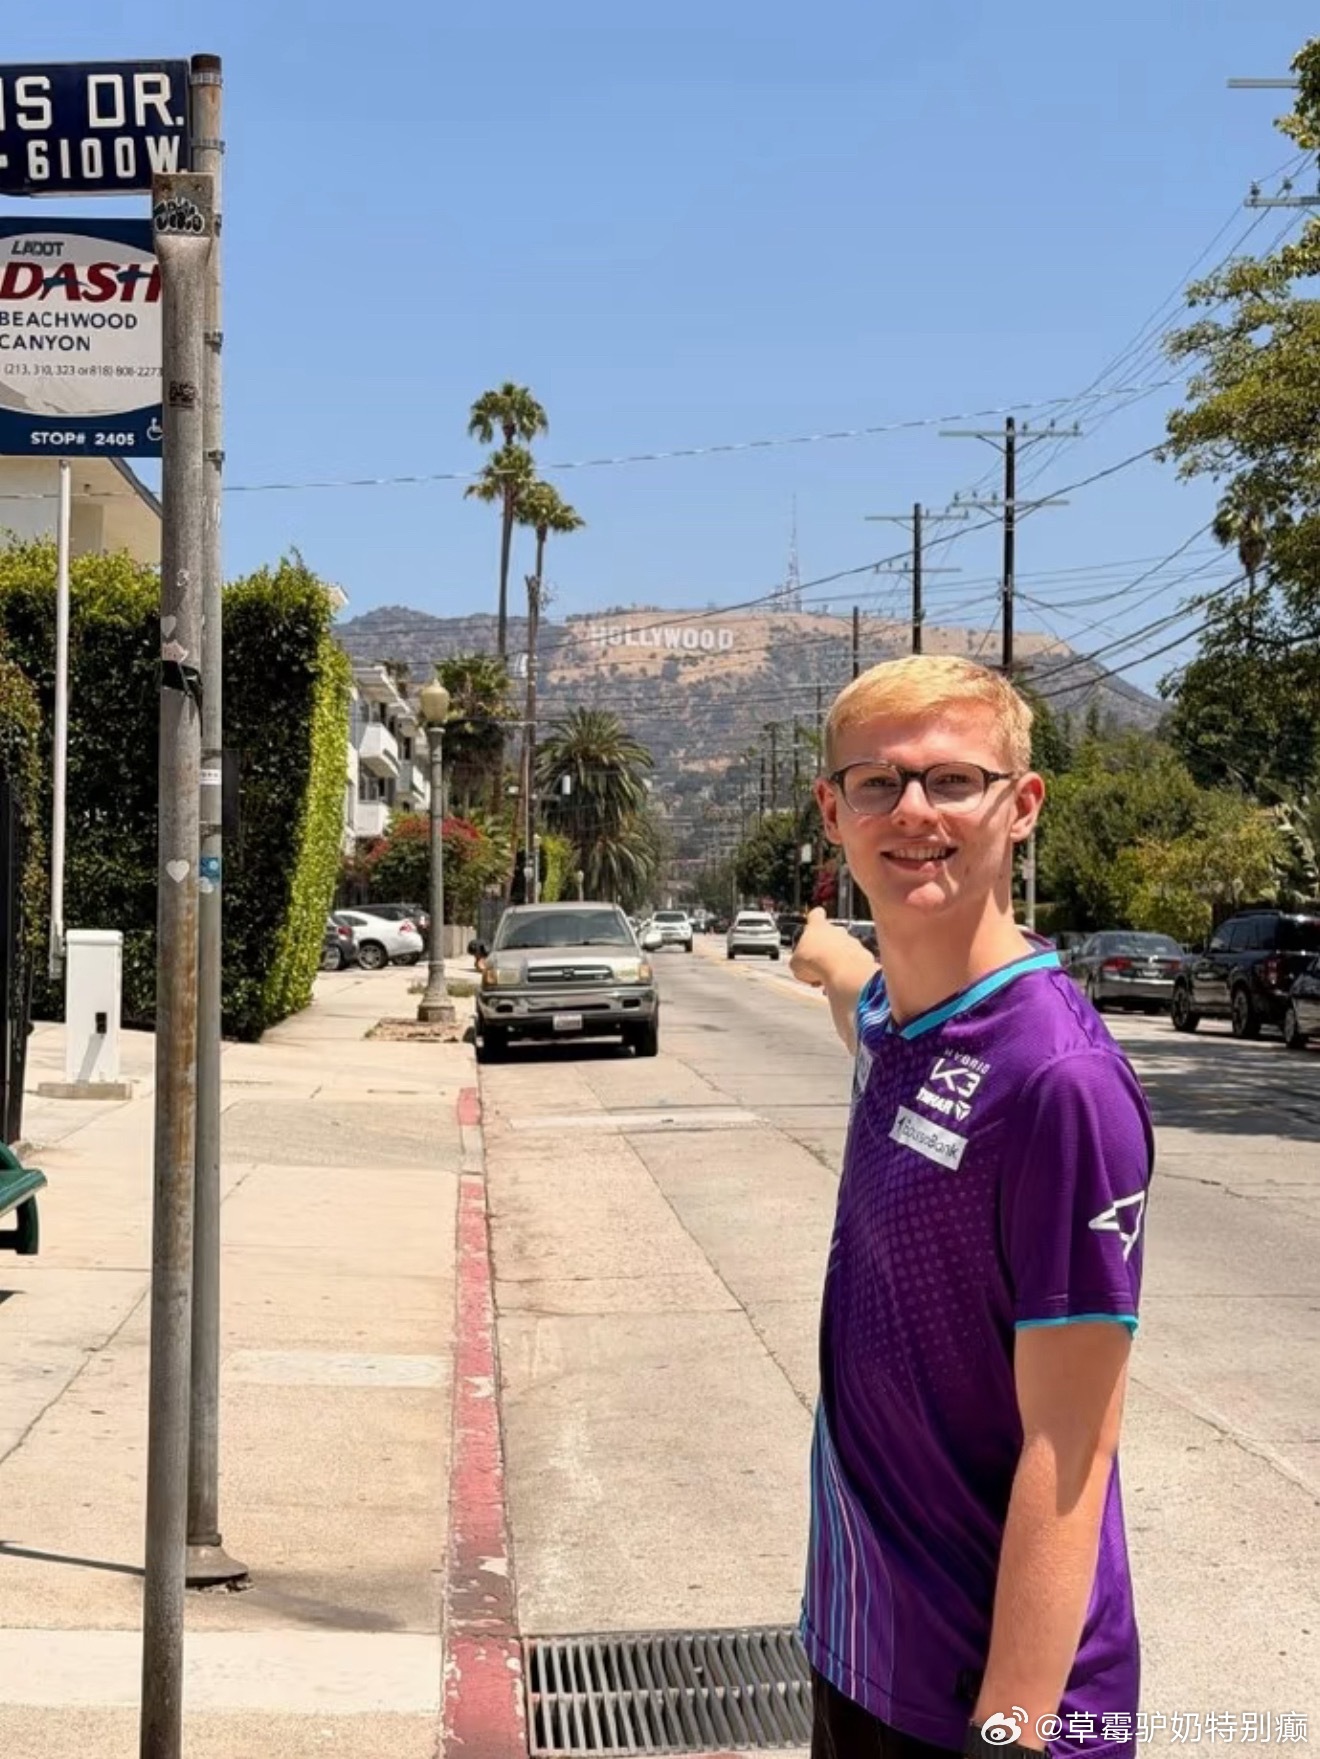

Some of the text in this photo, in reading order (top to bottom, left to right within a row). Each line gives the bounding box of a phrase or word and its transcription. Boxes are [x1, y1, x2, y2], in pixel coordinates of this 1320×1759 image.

[87, 73, 185, 128] DR.
[0, 262, 162, 303] DASH
[0, 311, 138, 329] BEACHWOOD
[0, 334, 91, 351] CANYON
[30, 432, 135, 445] STOP# 2405
[590, 624, 734, 650] HOLLYWOOD
